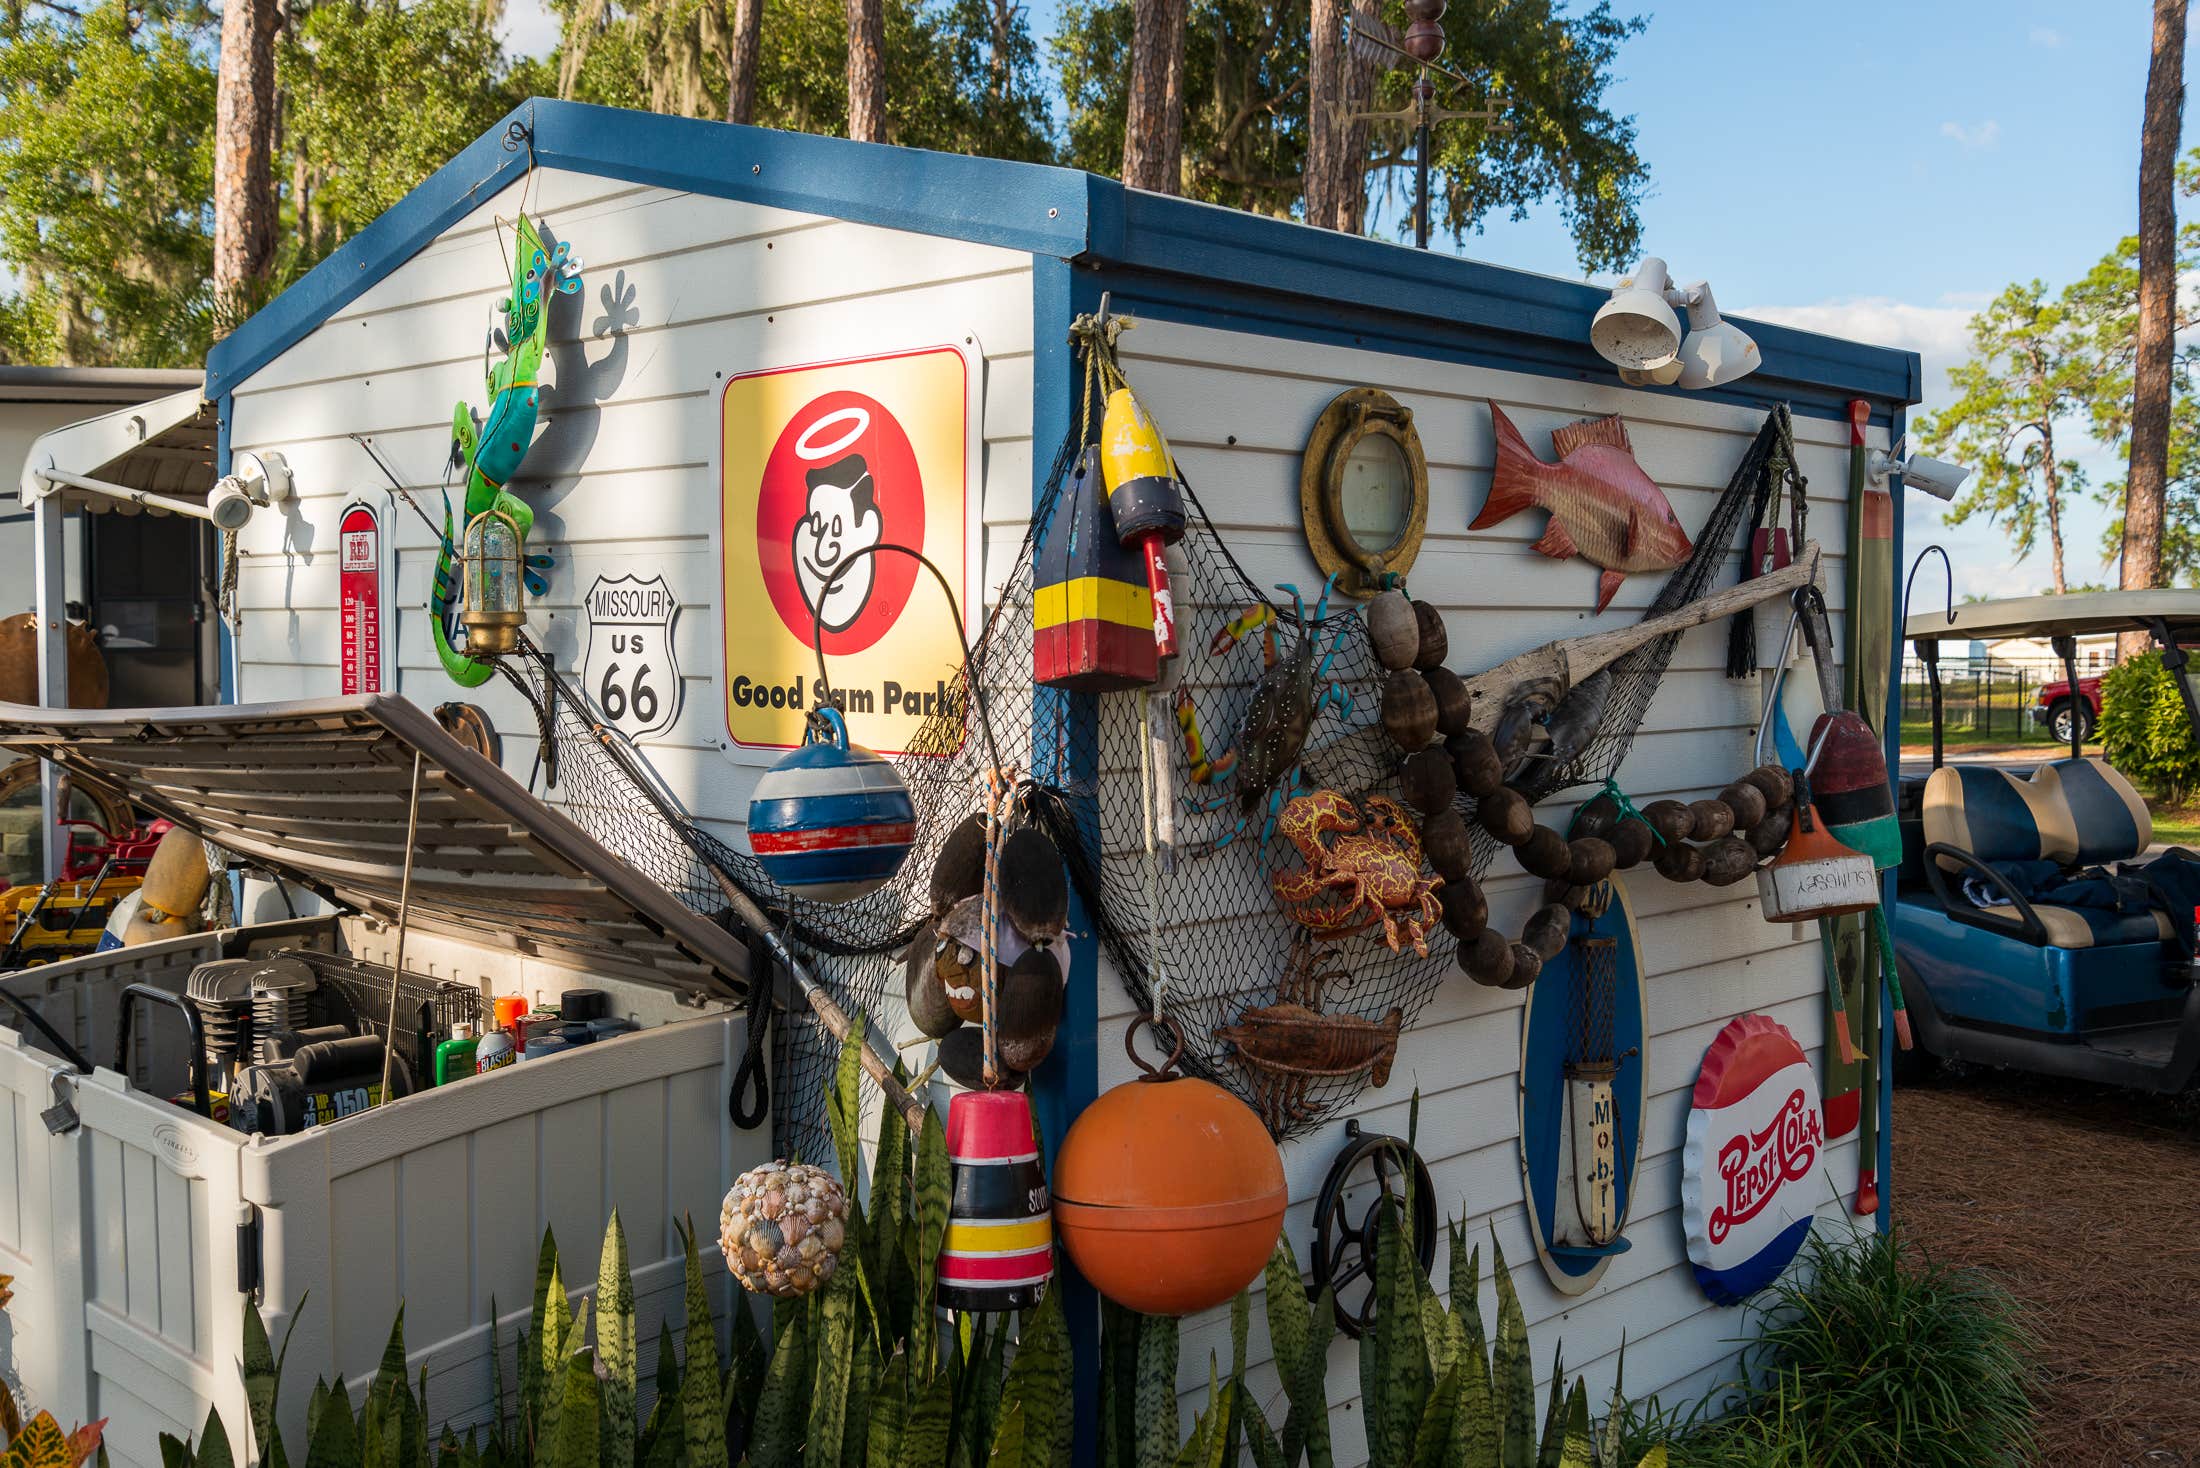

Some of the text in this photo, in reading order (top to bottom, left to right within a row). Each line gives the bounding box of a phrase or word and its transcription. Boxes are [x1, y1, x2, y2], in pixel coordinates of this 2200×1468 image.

[349, 541, 369, 561] RED
[595, 590, 665, 617] MISSOURI
[601, 662, 658, 723] 66
[733, 675, 955, 717] Good Sam Park
[334, 1087, 369, 1118] 150
